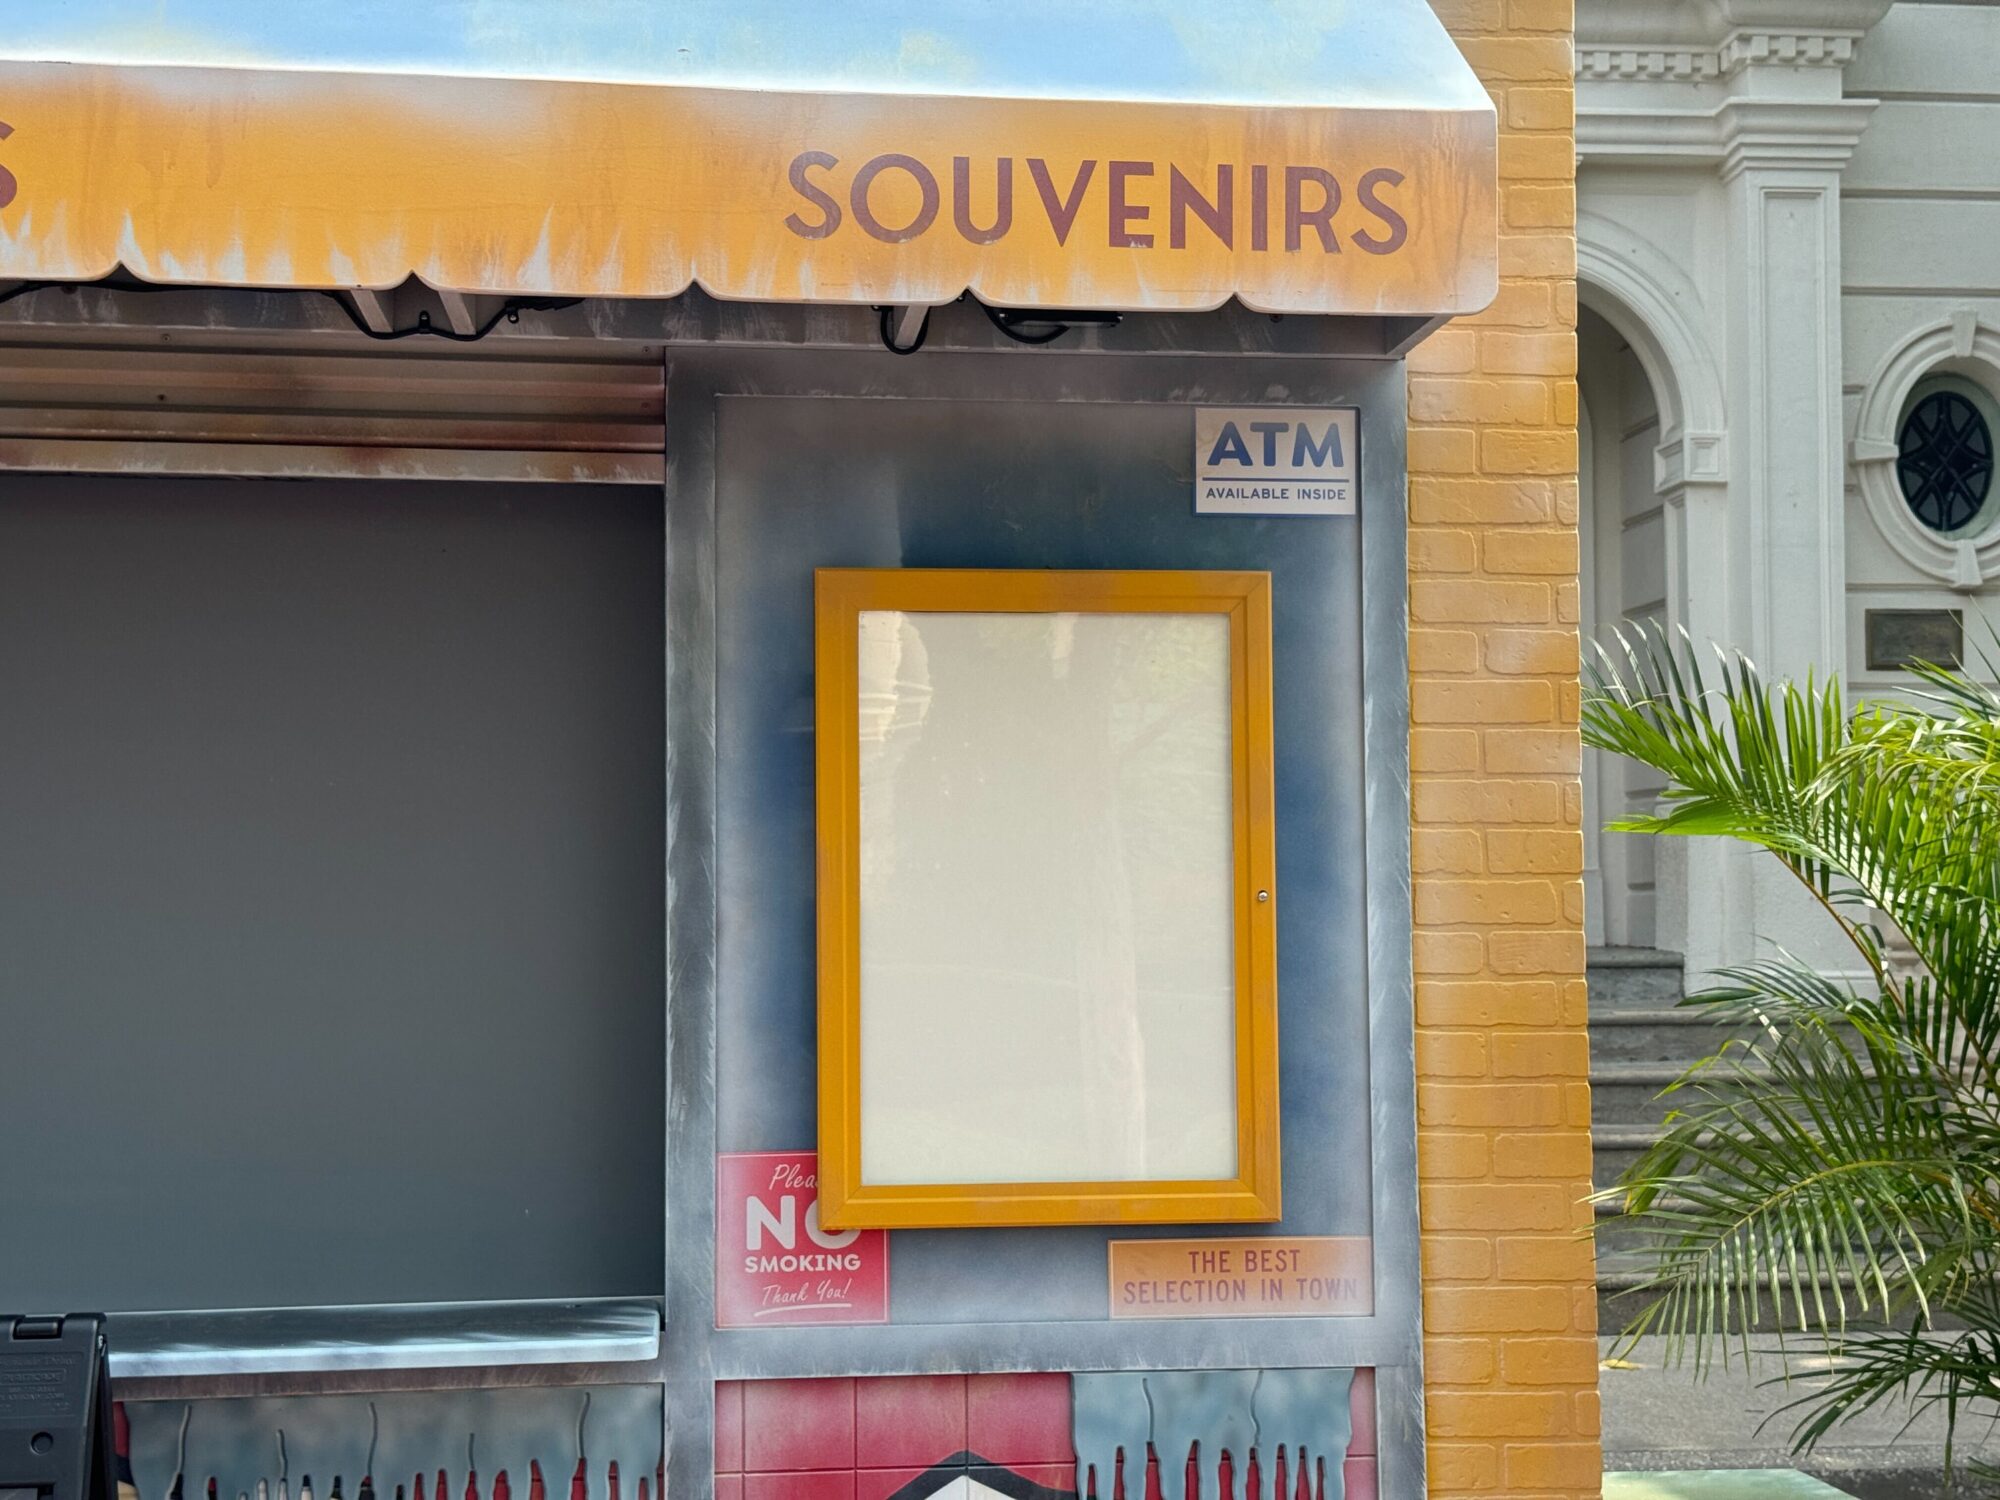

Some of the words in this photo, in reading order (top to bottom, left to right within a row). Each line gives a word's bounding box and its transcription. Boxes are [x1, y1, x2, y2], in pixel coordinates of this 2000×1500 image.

[784, 150, 1408, 256] SOUVENIRS
[1207, 421, 1344, 467] ATM
[1206, 488, 1289, 499] AVAILABLE
[1297, 488, 1346, 500] INSIDE
[768, 1163, 818, 1190] Plea
[745, 1254, 861, 1273] SMOKING
[1189, 1251, 1231, 1273] THE
[1245, 1249, 1300, 1272] BEST
[762, 1282, 809, 1306] Thank
[816, 1278, 852, 1302] You!
[1123, 1279, 1246, 1304] SELECTION
[1261, 1279, 1283, 1300] IN
[1296, 1278, 1357, 1300] TOWN
